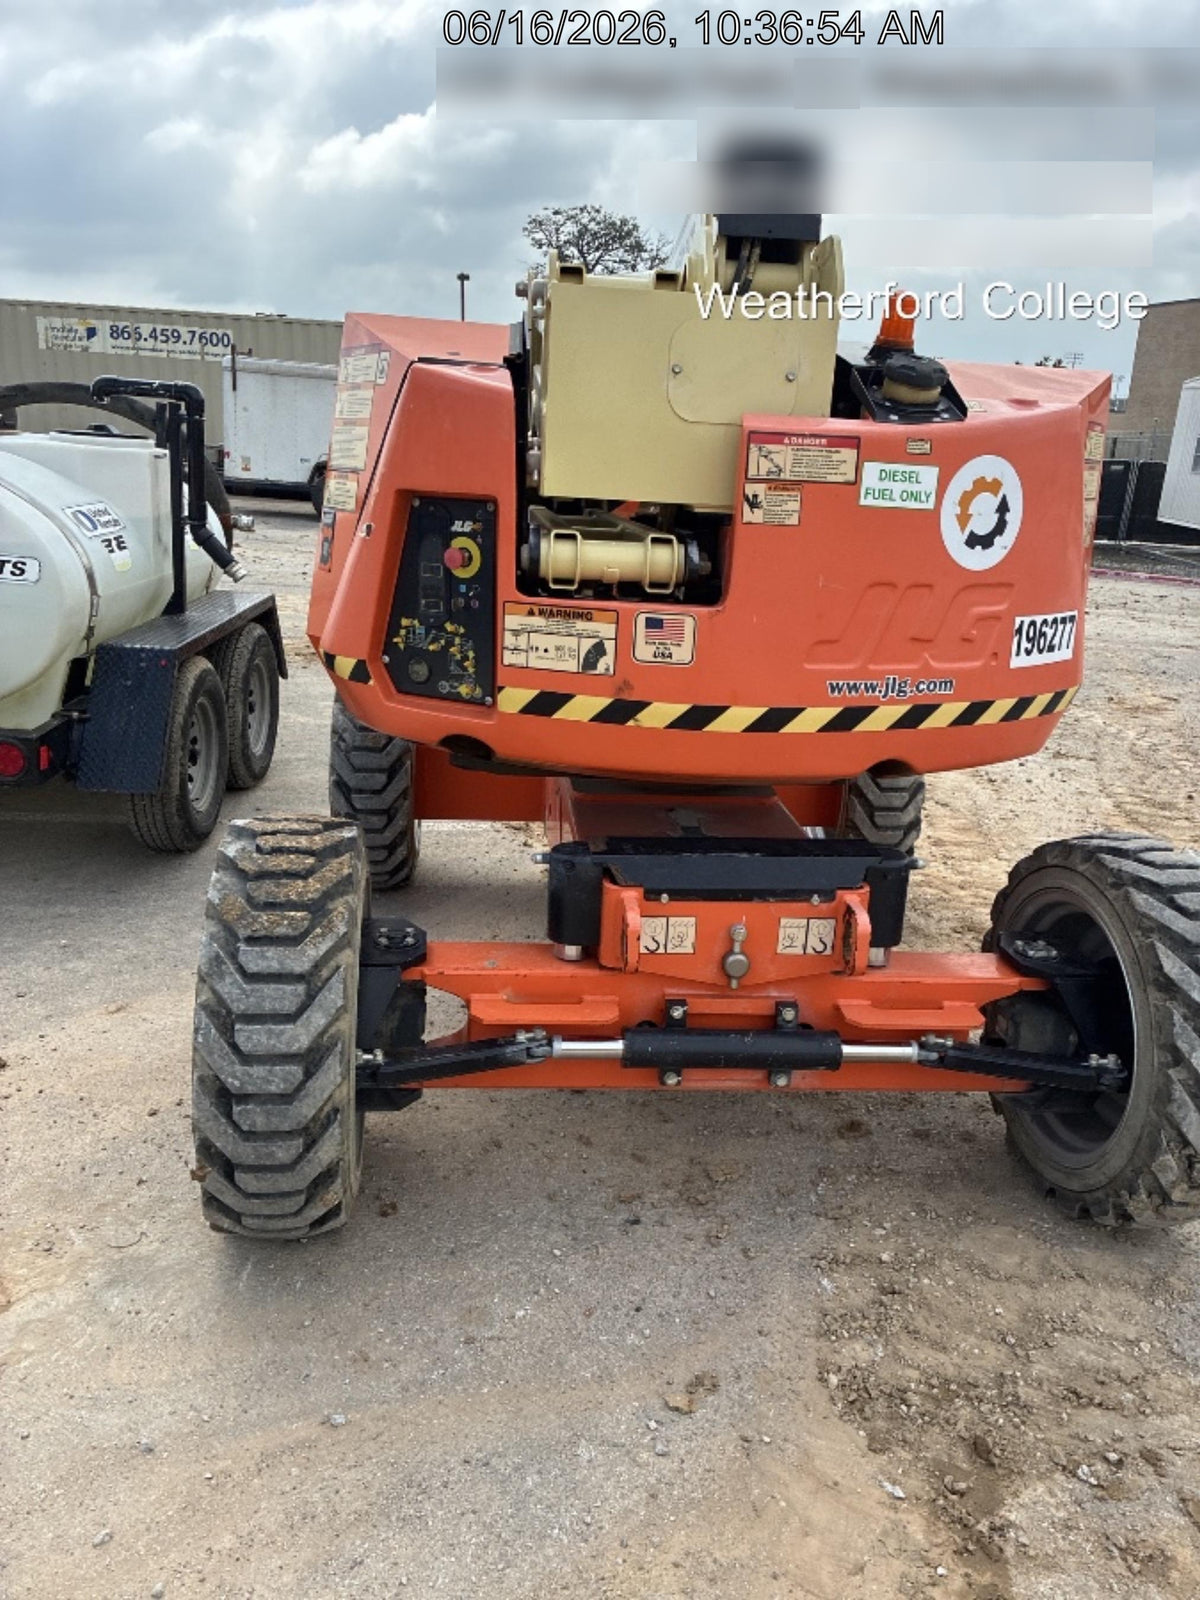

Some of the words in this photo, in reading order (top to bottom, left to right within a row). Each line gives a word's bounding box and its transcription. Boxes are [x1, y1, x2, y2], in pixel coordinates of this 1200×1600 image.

[109, 324, 232, 348] 866.459.7600
[878, 468, 922, 484] DIESEL
[863, 487, 897, 502] FUEL
[900, 490, 932, 504] ONLY
[451, 520, 473, 533] JLG
[538, 607, 593, 621] WARNING
[803, 582, 1015, 669] JLG
[1014, 614, 1077, 658] 196277
[653, 650, 673, 660] USA
[826, 676, 955, 699] www.jlg.com
